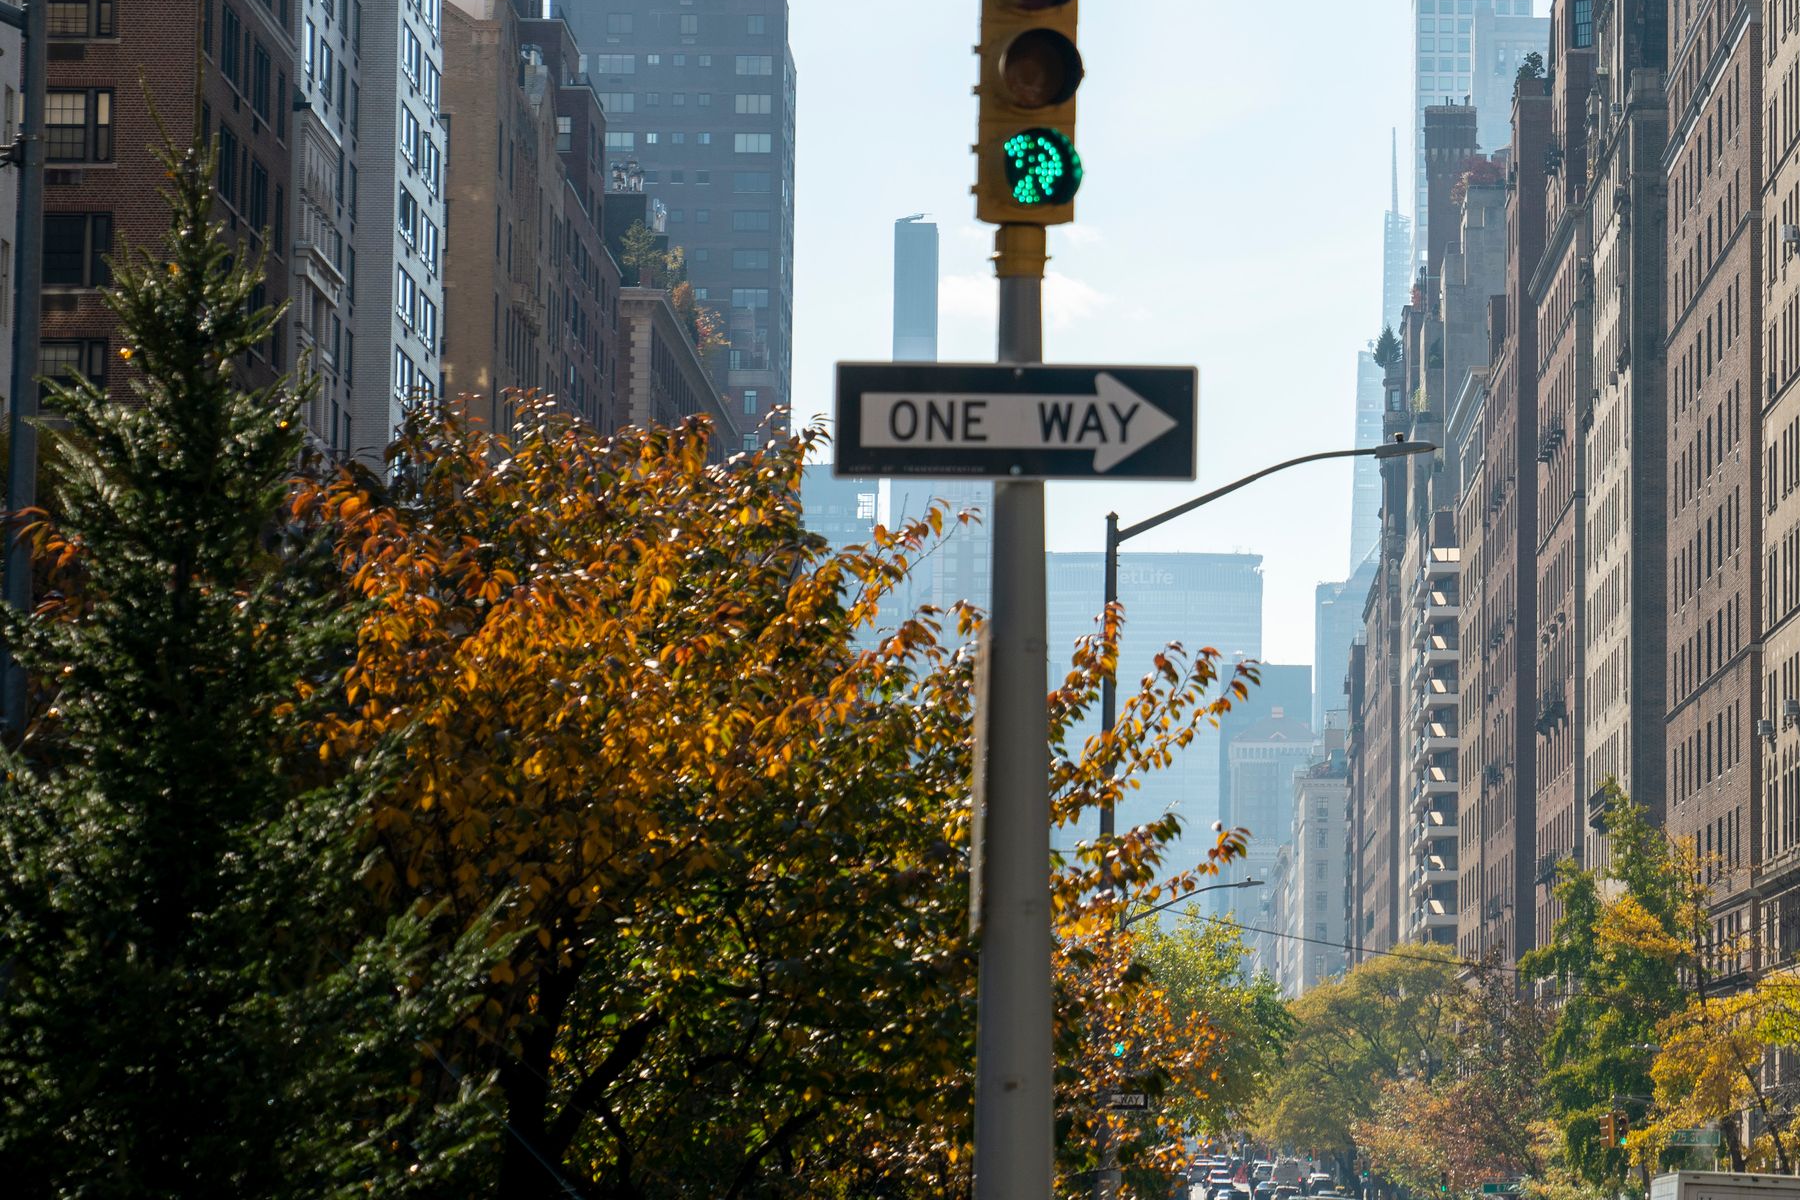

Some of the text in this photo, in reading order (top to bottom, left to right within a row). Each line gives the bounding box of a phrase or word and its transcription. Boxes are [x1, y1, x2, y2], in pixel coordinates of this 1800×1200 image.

[889, 400, 1140, 443] ONE WAY
[1119, 567, 1174, 584] etLife
